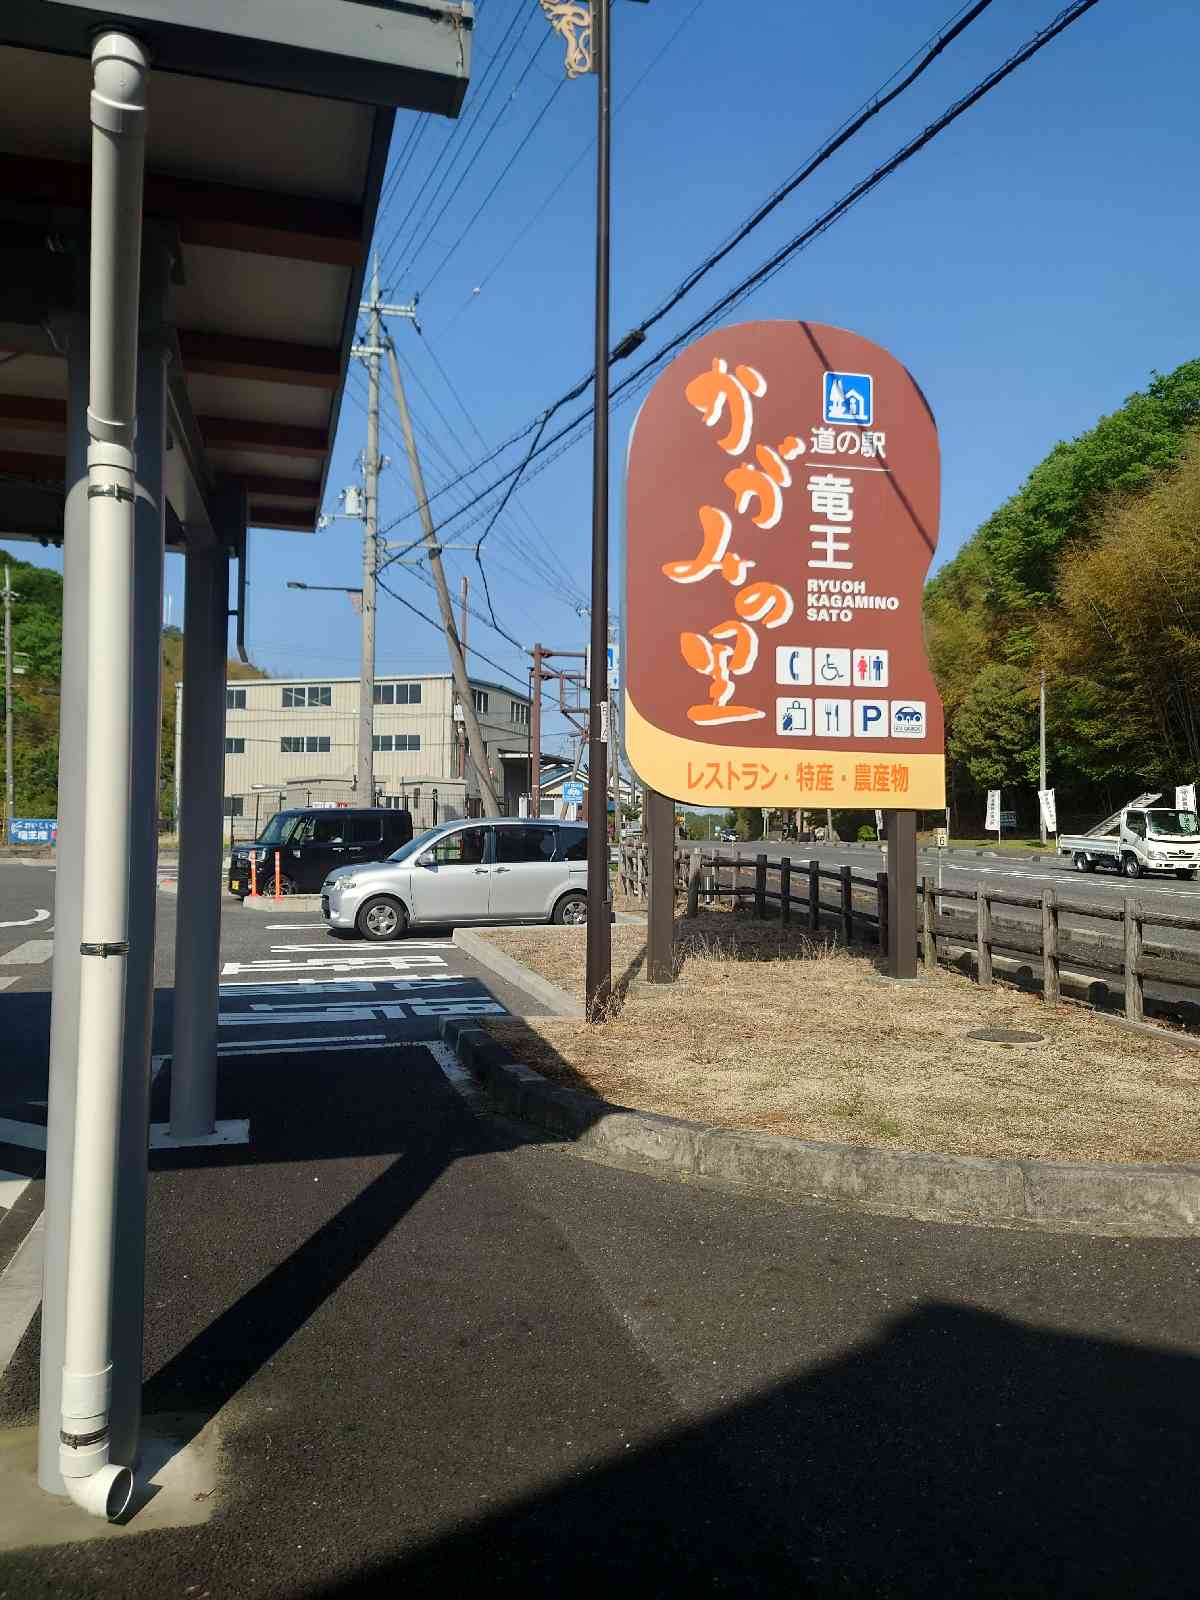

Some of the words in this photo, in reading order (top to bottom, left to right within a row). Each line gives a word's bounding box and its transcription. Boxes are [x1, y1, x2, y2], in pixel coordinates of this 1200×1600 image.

[810, 427, 886, 459] 道の駅
[806, 473, 854, 570] 竜王
[662, 357, 806, 727] かがみの里
[807, 578, 867, 594] RYUOH
[806, 607, 853, 622] SATO
[807, 592, 900, 610] KAGAMINO
[863, 705, 882, 731] P
[687, 760, 909, 793] レストラン・特産・農産物
